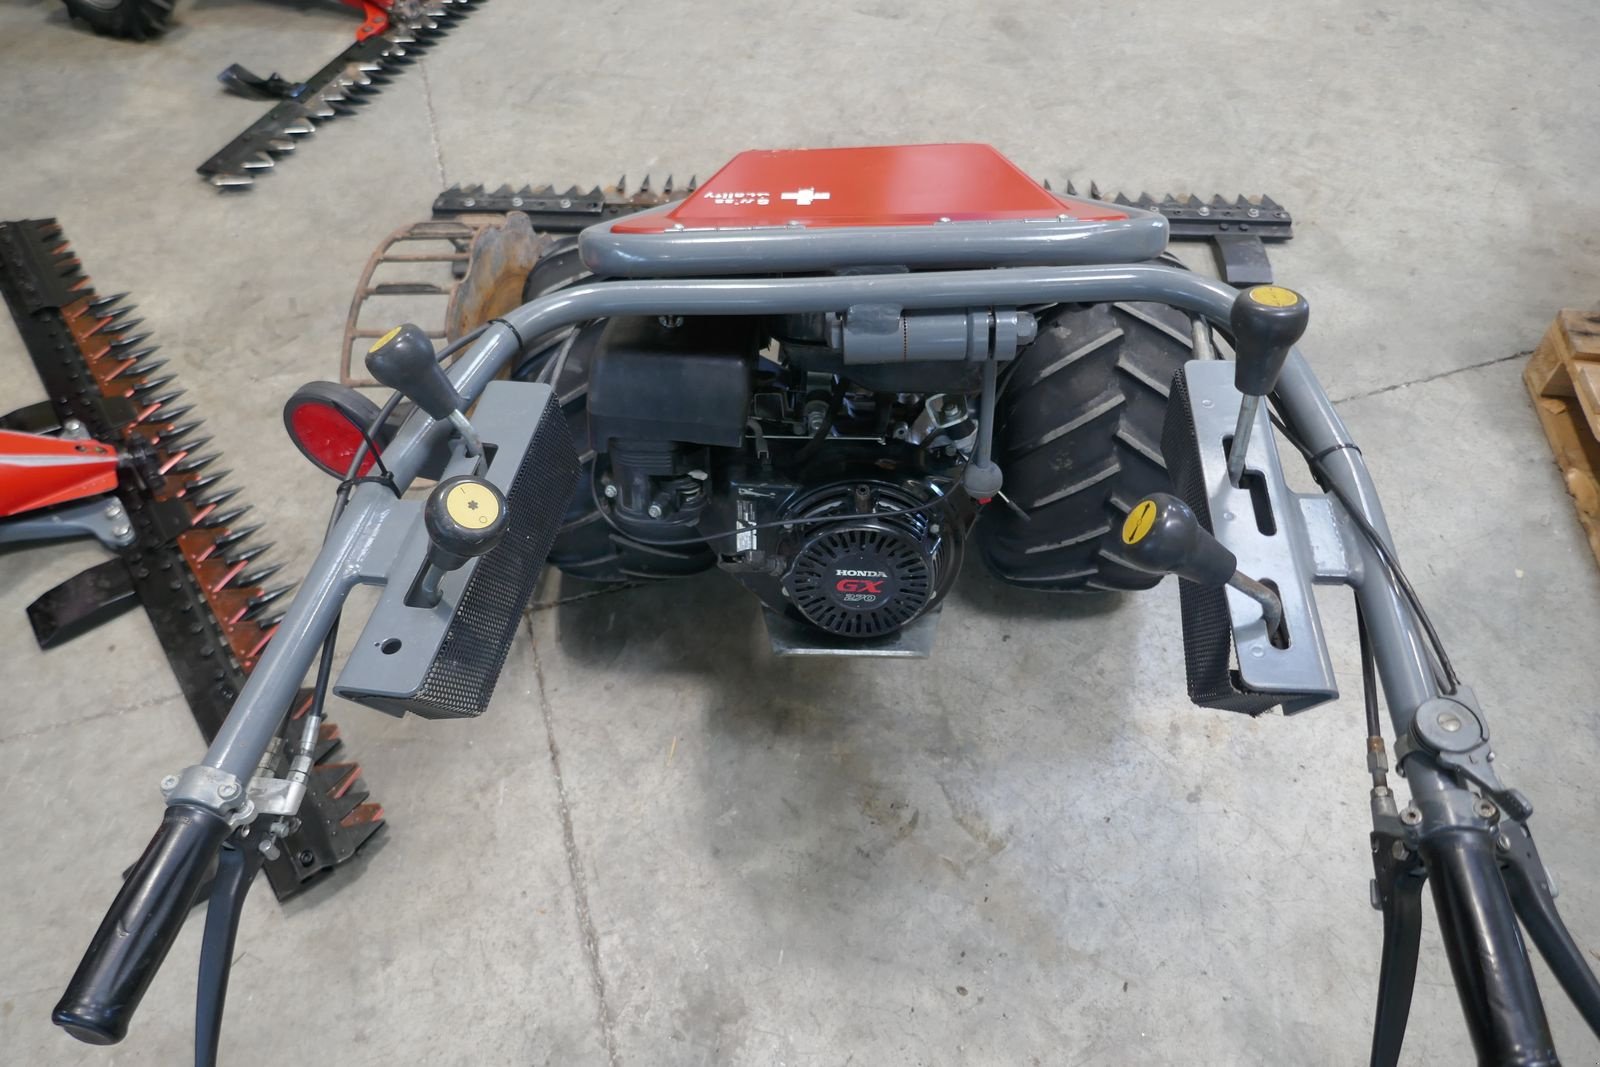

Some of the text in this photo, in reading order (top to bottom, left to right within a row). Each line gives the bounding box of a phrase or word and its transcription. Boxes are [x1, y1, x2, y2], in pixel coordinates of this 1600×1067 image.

[835, 569, 888, 578] HONDA
[835, 579, 885, 593] GX
[843, 594, 877, 602] 270
